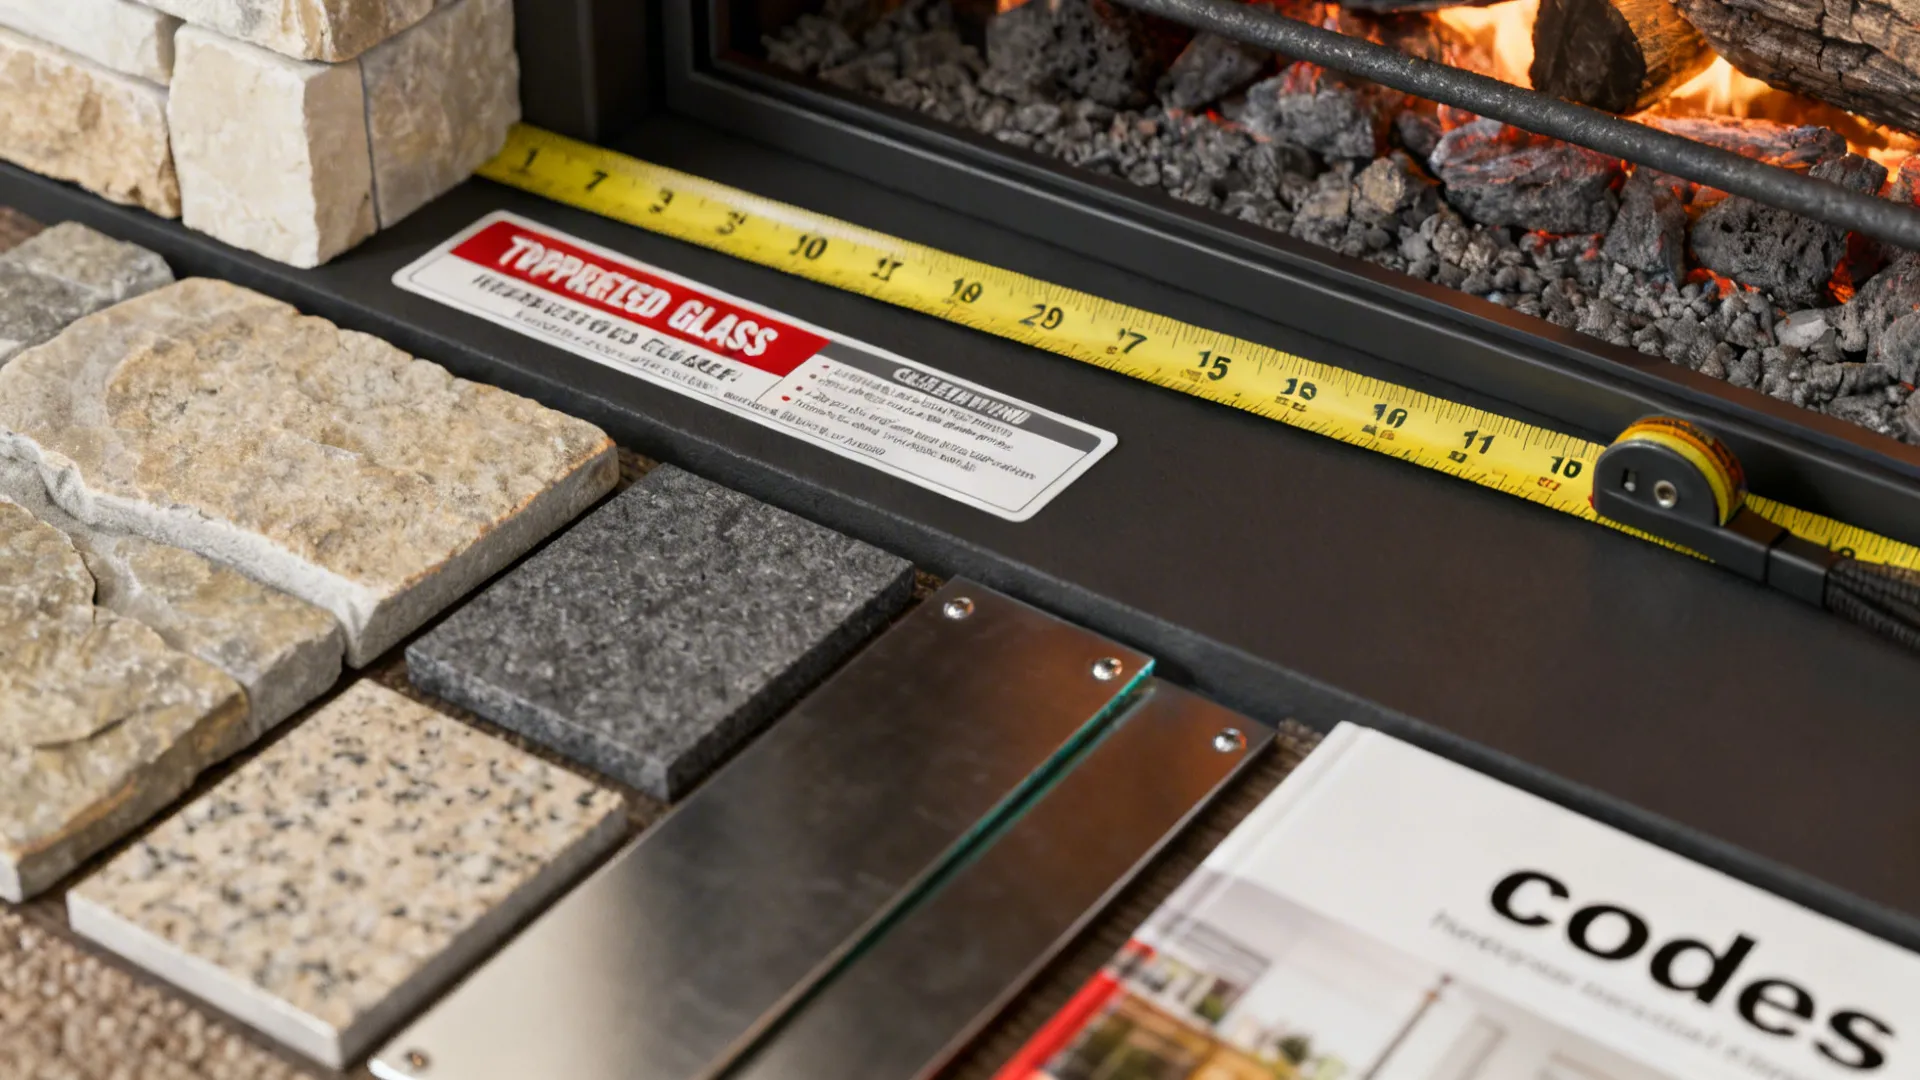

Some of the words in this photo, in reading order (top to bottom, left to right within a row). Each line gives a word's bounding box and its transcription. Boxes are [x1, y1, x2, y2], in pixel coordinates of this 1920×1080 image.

[667, 299, 779, 357] GLASS
[1197, 350, 1232, 381] 15
[1463, 429, 1496, 455] 11
[1551, 455, 1583, 479] 10
[1489, 869, 1897, 1071] codes
